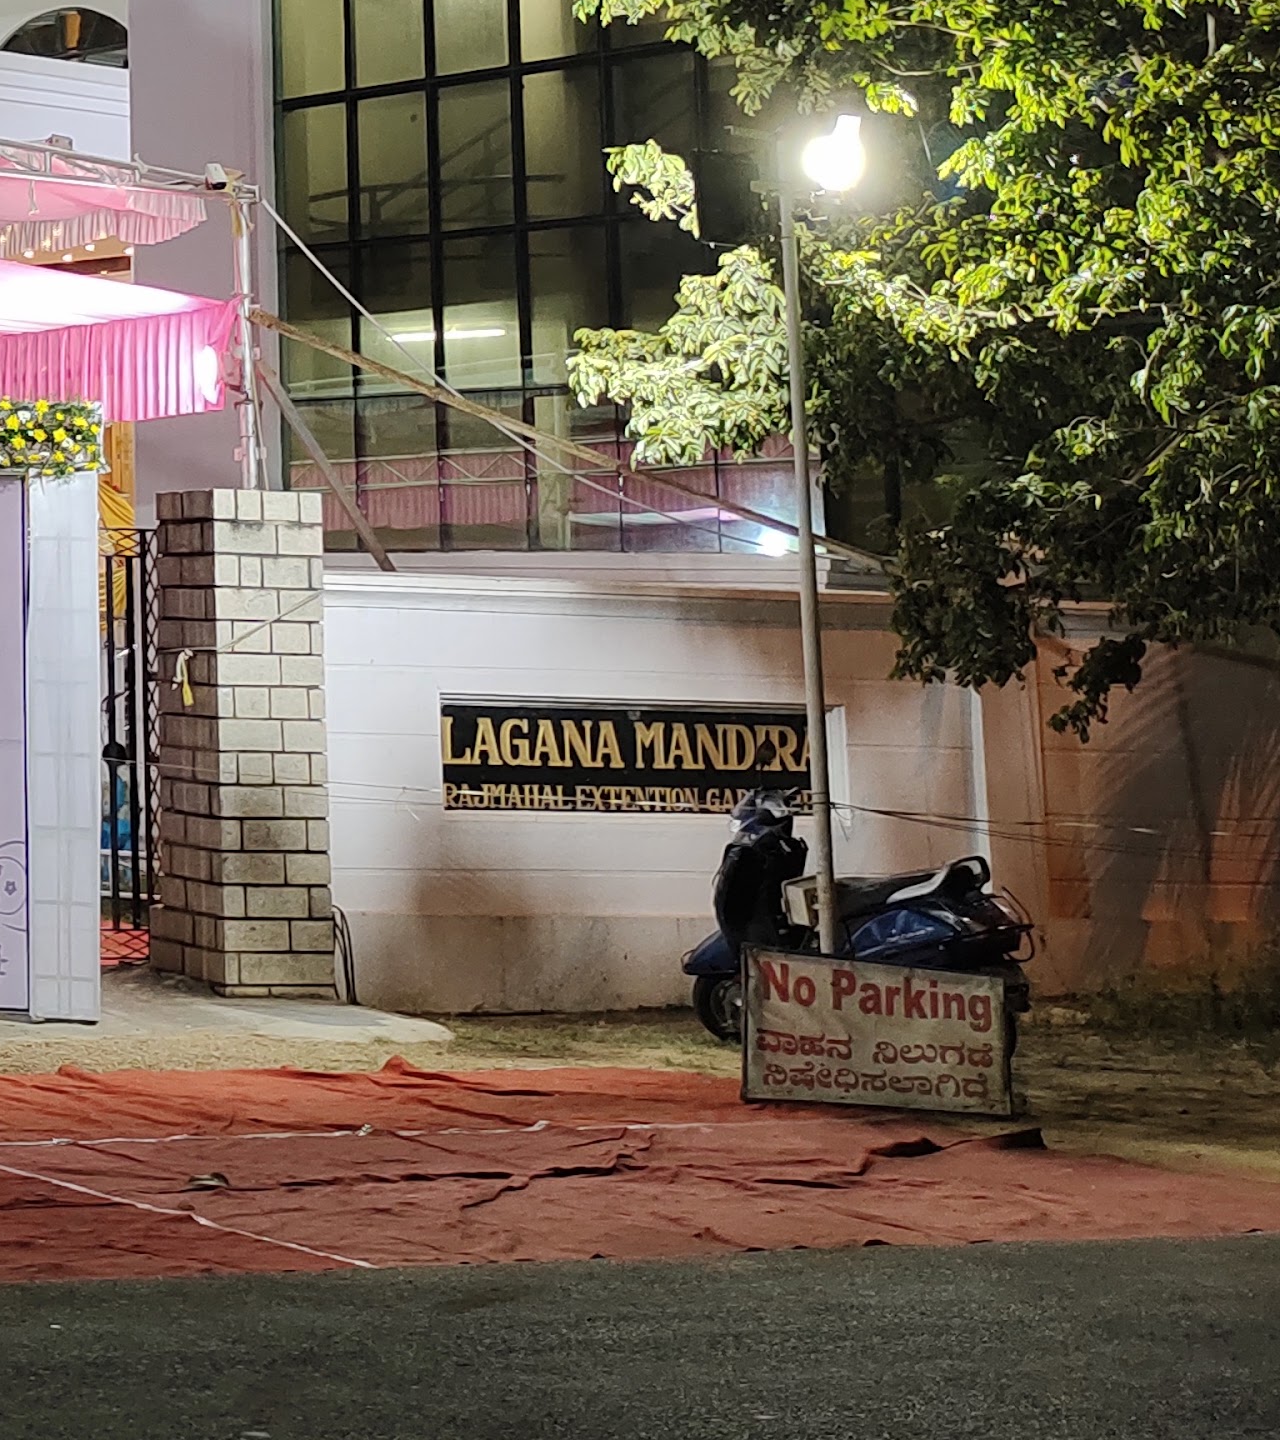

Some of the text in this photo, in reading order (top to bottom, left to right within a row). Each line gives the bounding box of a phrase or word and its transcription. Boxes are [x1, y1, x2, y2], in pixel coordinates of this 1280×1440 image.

[441, 716, 811, 772] LAGANA MANDIR
[443, 782, 573, 810] RAJMAHAL
[575, 785, 700, 811] EXTENTION
[761, 961, 991, 1032] No Parking
[756, 1028, 993, 1068] ವಾಹನ ನಿಲುಗಡೆ
